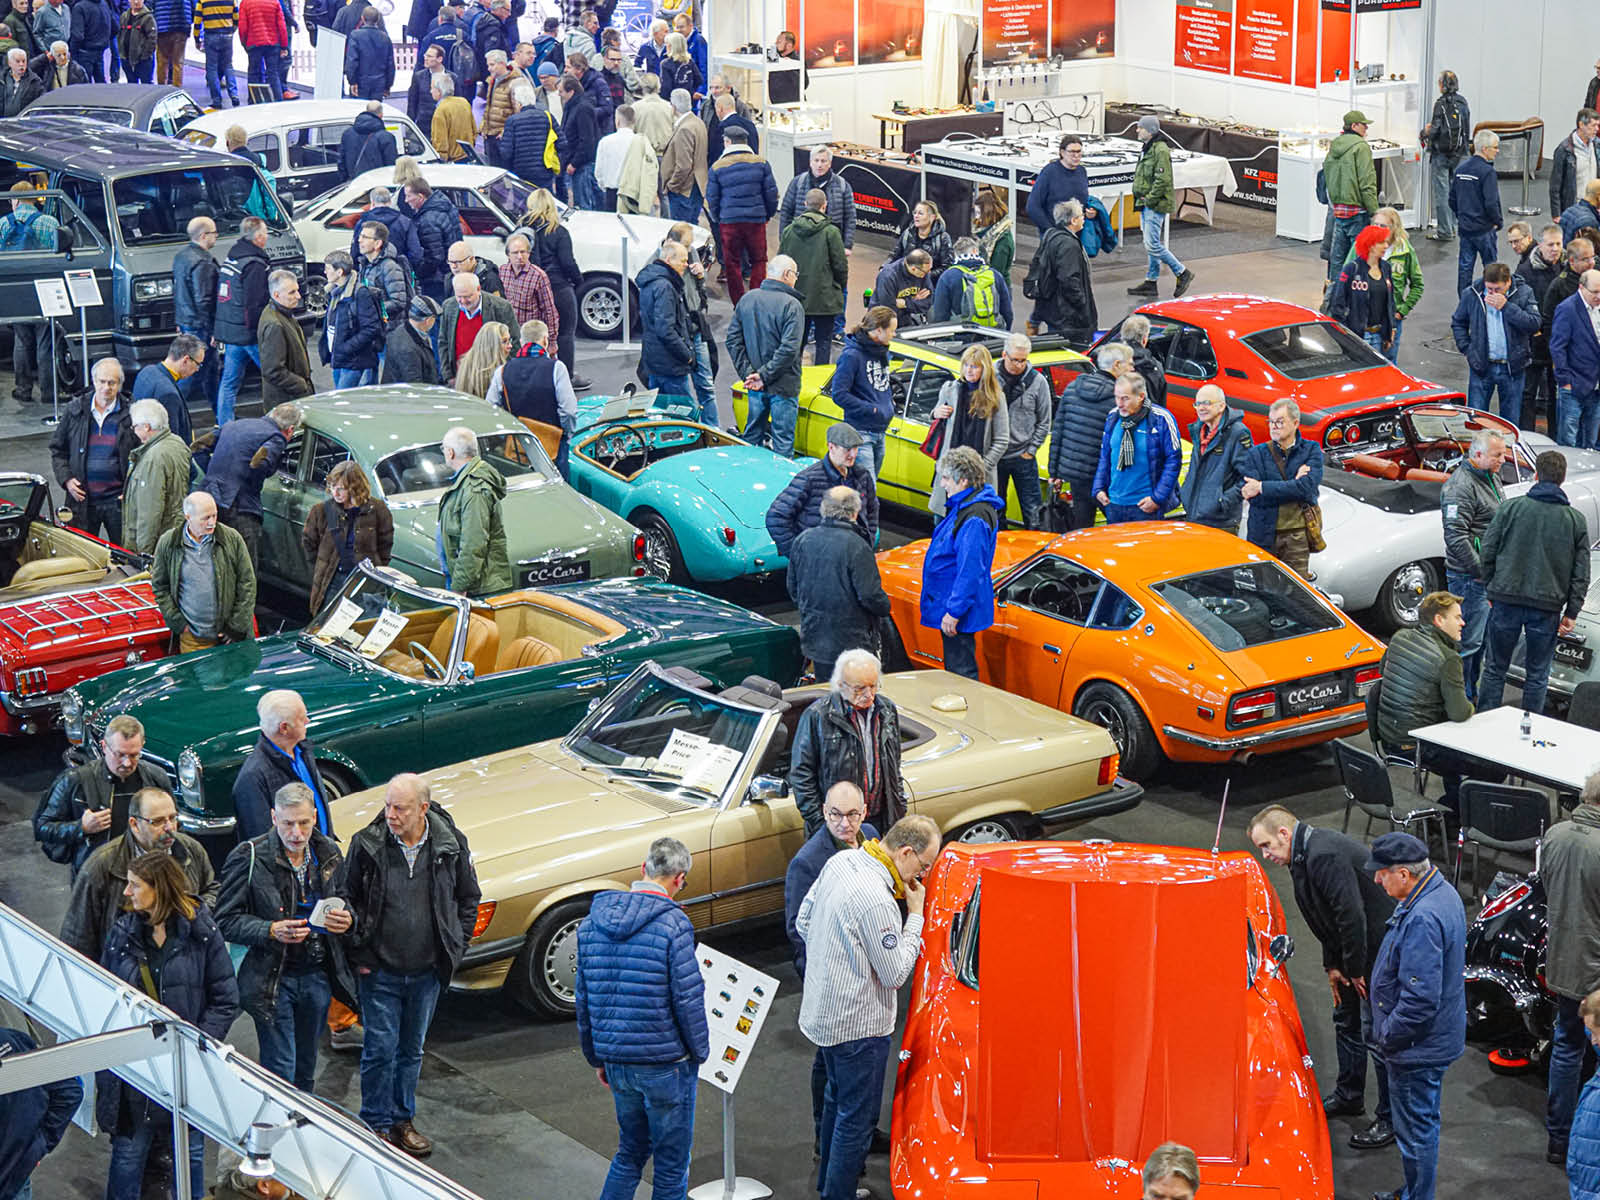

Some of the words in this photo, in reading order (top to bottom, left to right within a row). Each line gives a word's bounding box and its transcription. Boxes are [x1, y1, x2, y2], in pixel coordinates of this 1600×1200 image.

[931, 157, 1004, 177] www.schwarzbach-classic.de
[1244, 168, 1259, 177] KFZ
[528, 565, 584, 582] CC-Cars
[1555, 643, 1585, 660] Cars
[1288, 684, 1342, 705] CC-Cars
[673, 738, 702, 750] Messe-
